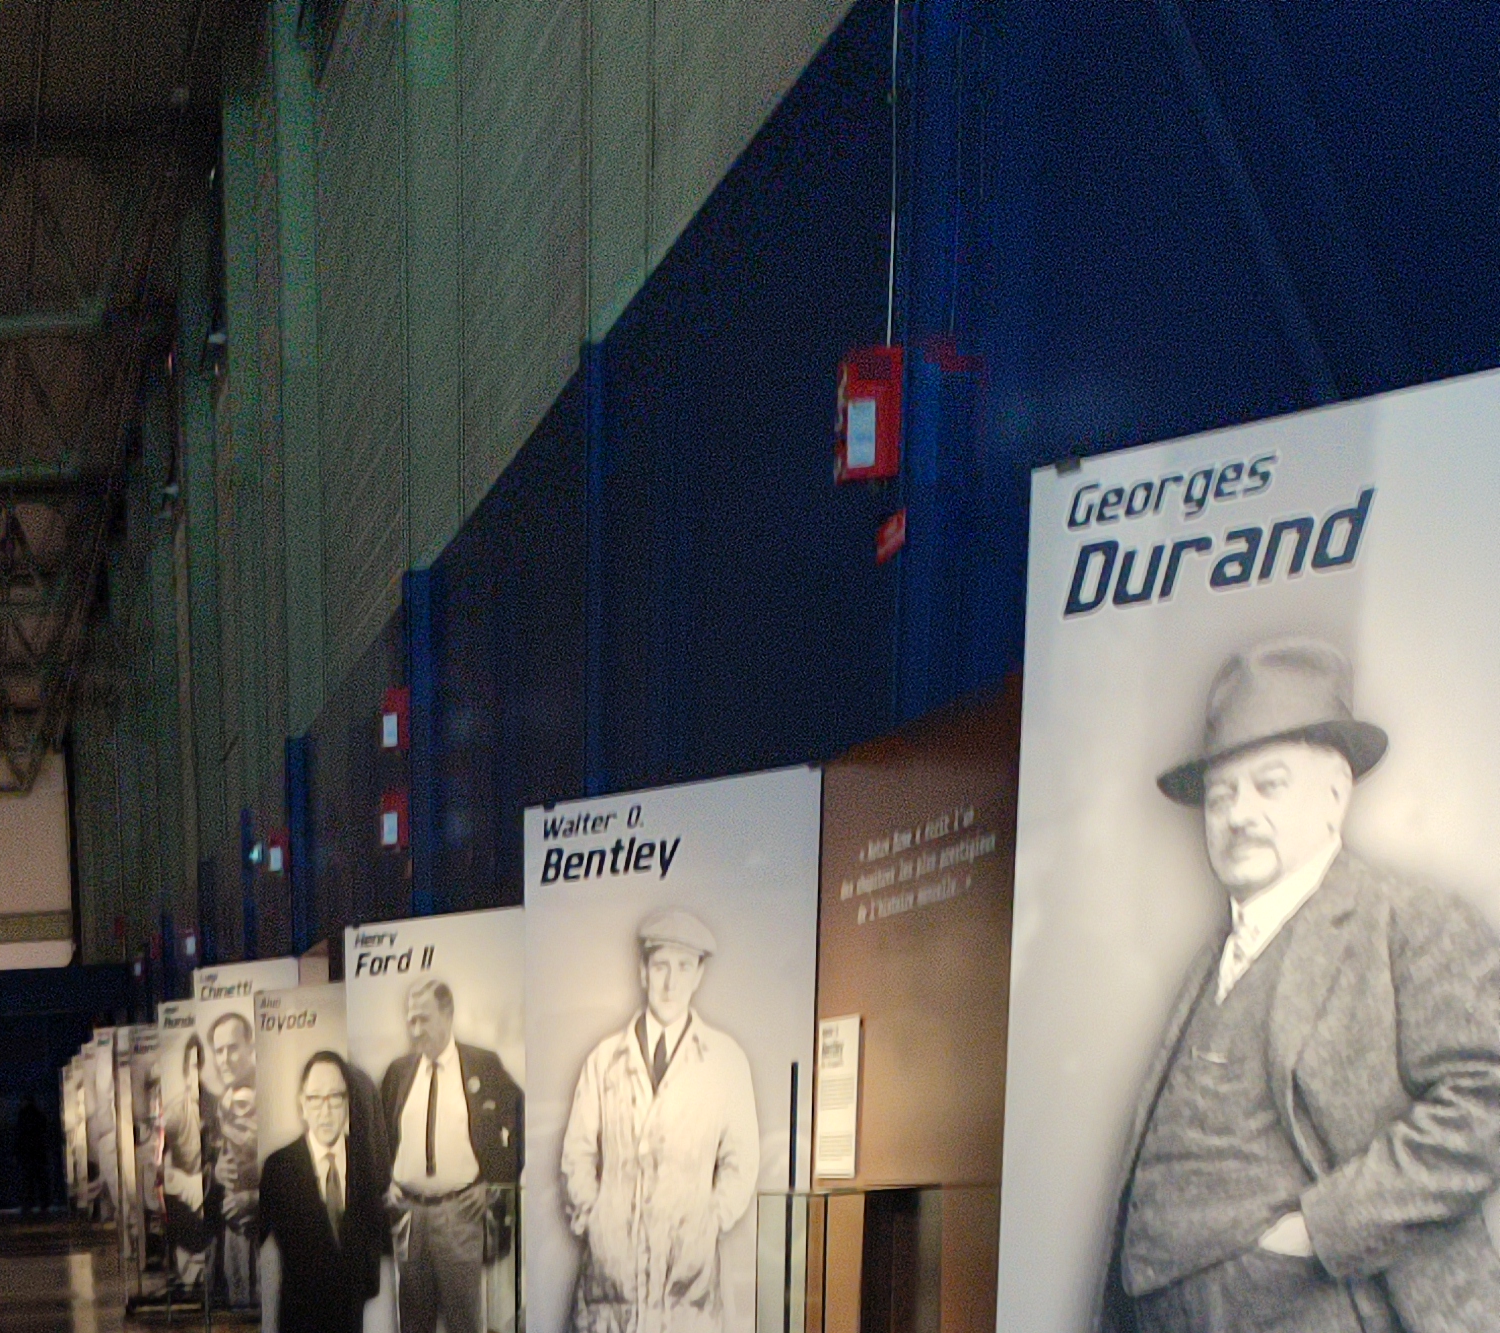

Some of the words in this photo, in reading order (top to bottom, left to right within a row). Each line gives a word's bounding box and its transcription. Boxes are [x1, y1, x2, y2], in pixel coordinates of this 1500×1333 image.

[1067, 453, 1278, 531] Georges
[1062, 486, 1376, 619] Durand
[543, 811, 618, 841] Walter
[540, 835, 681, 886] Bentley
[355, 945, 413, 978] Ford
[260, 1009, 317, 1033] Toyoda
